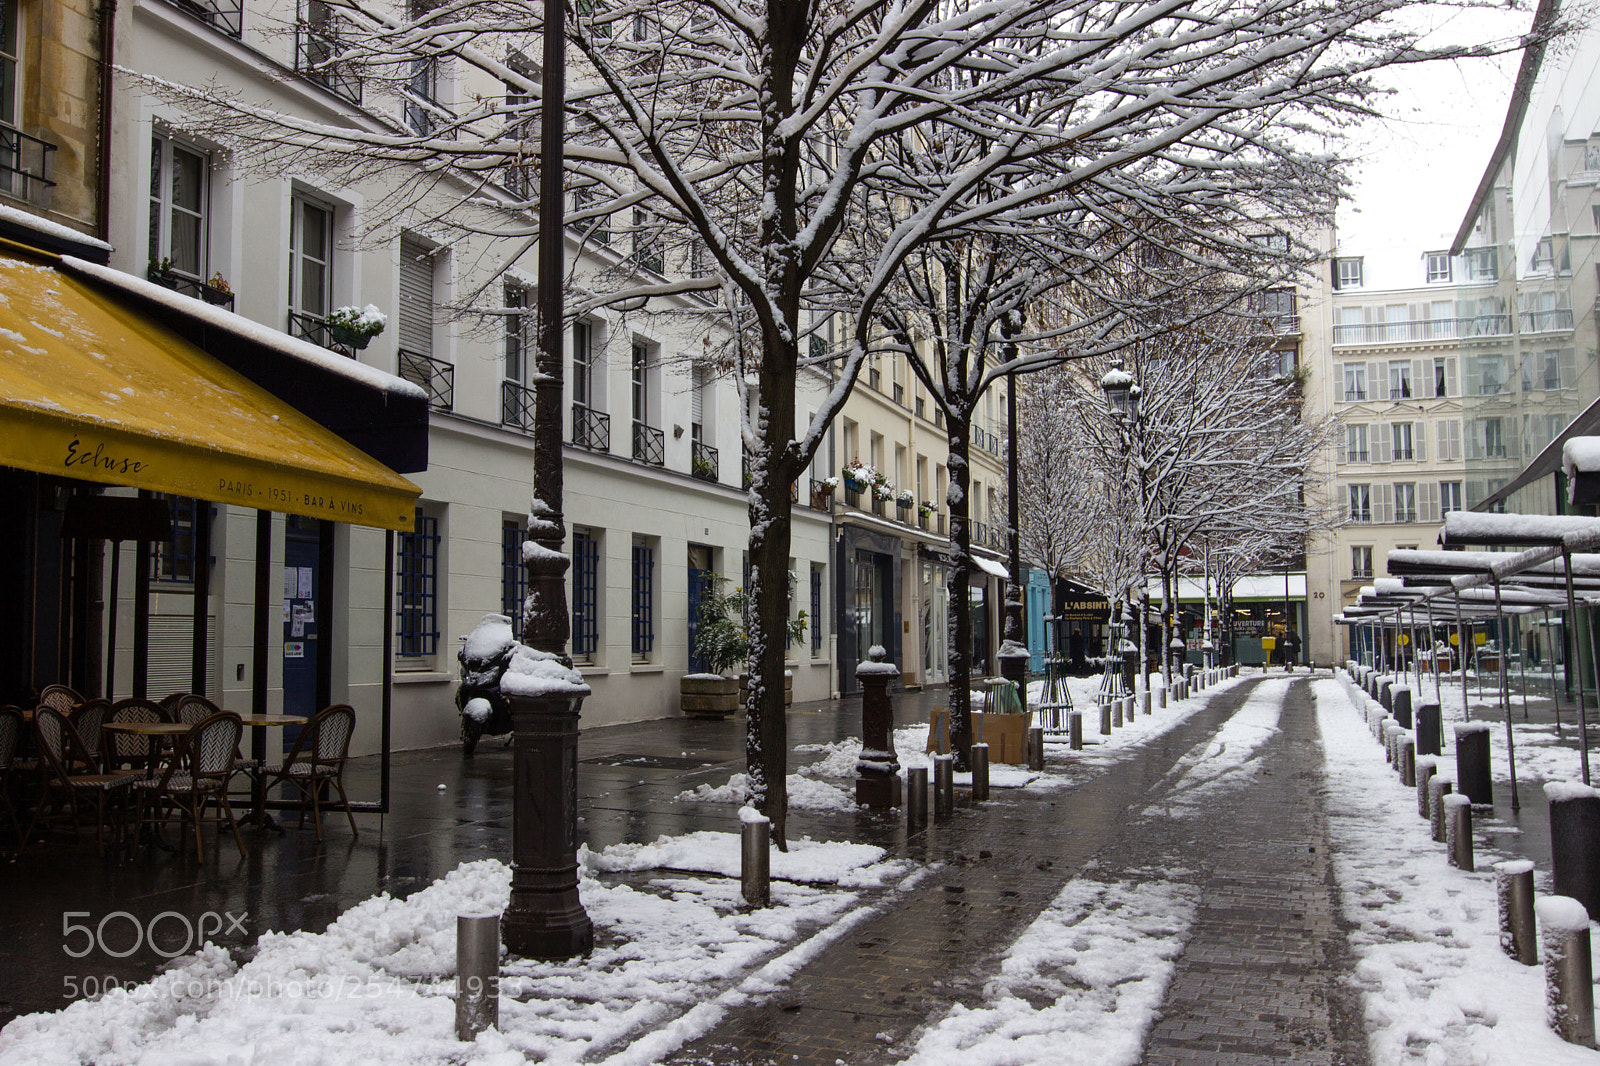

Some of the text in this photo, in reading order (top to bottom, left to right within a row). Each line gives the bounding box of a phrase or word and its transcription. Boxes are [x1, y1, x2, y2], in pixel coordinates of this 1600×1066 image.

[219, 479, 363, 515] PARIS 1951 BAR À VINS
